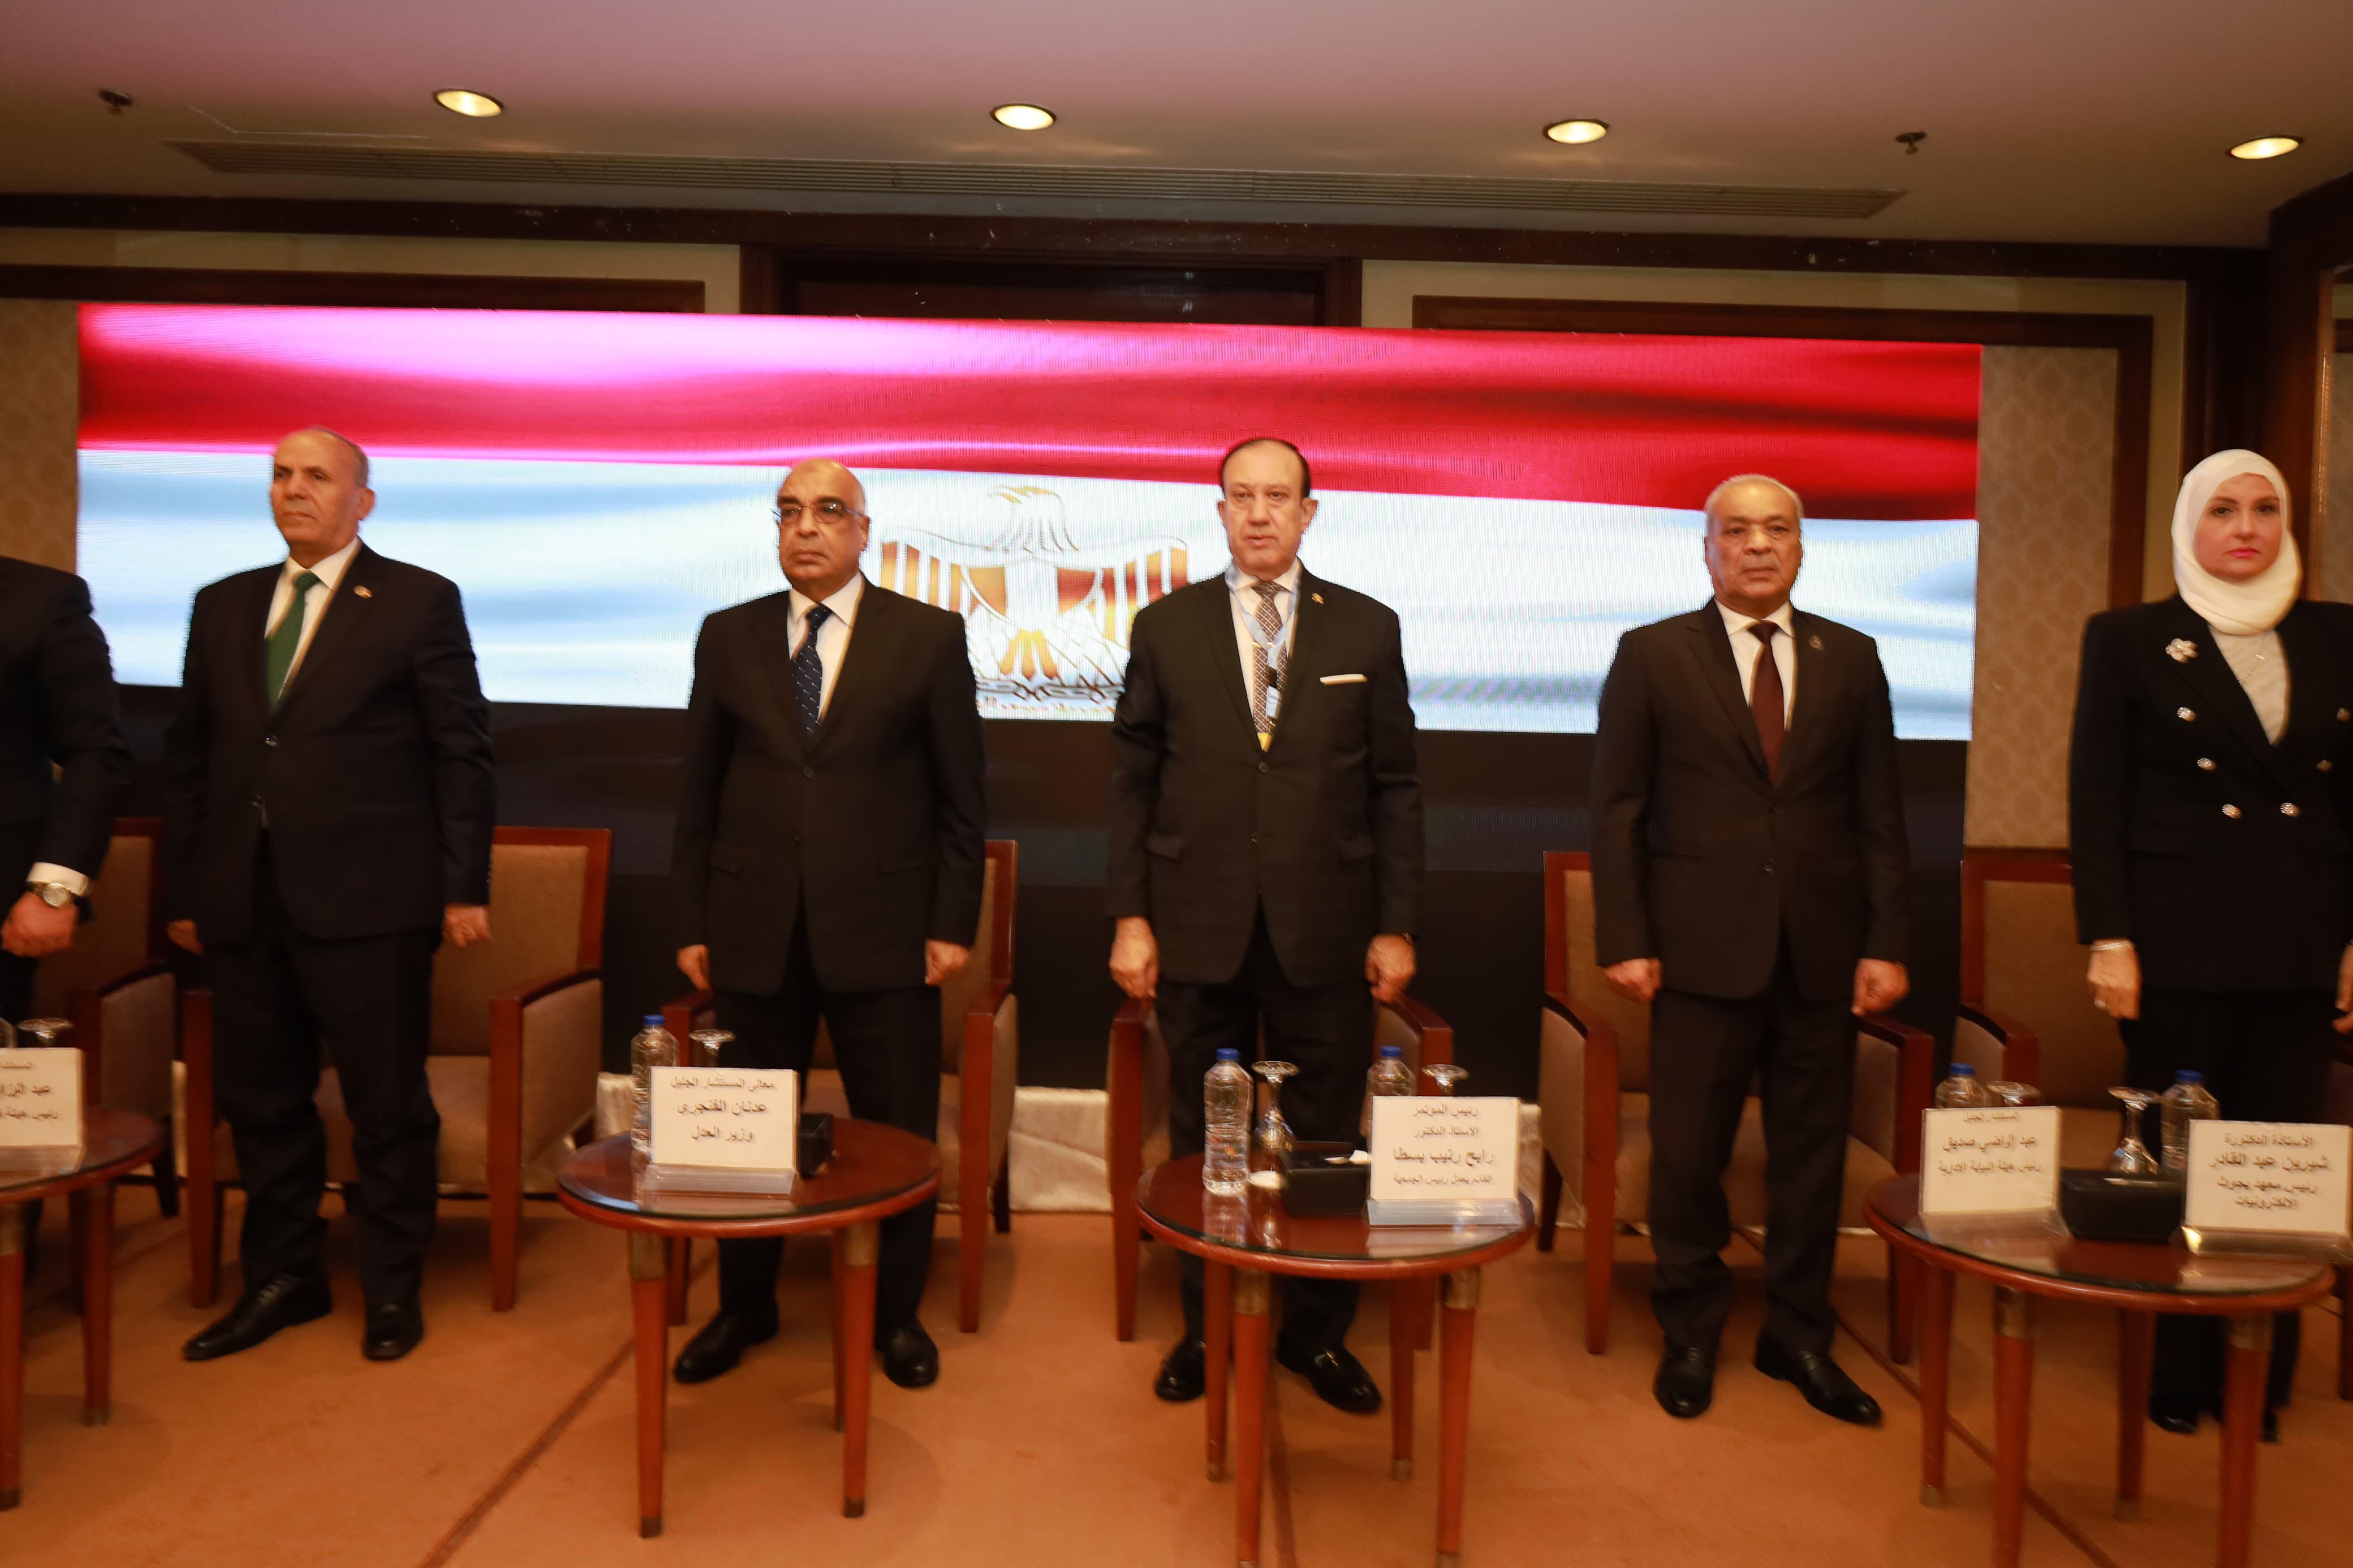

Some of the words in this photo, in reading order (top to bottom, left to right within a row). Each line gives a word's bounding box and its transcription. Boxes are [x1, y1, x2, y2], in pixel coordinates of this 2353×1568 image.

[670, 1076, 698, 1088] الجليل
[701, 1077, 744, 1088] المستشار
[0, 1082, 24, 1098] الرزا
[31, 1085, 51, 1096] عبد
[6, 1107, 27, 1120] هيئة
[32, 1109, 59, 1120] رئيس
[731, 1100, 766, 1116] عدنان
[1963, 1112, 1984, 1123] الجليل
[1986, 1112, 2018, 1123] المستشار
[691, 1124, 720, 1140] العدل
[724, 1128, 753, 1142] وزير
[1412, 1125, 1445, 1138] الدكتور
[1942, 1136, 1975, 1152] صديق
[2019, 1135, 2036, 1148] عبد
[2225, 1133, 2268, 1147] الدكتورة
[1393, 1146, 1424, 1164] بسطا
[1429, 1148, 1460, 1164] رتيب
[1466, 1148, 1494, 1167] رابح
[2208, 1151, 2247, 1168] القادر
[1970, 1159, 1994, 1173] النيابة
[1997, 1159, 2014, 1173] هيئة
[2018, 1159, 2041, 1173] رئيس
[2252, 1156, 2275, 1170] عبد
[2282, 1155, 2329, 1173] شيرين
[1394, 1173, 1422, 1186] الجمعية
[1425, 1175, 1449, 1186] رئيس
[1451, 1174, 1470, 1186] بعمل
[2217, 1176, 2249, 1191] بحوث
[2253, 1180, 2281, 1193] معهد
[2285, 1182, 2317, 1195] رئيس
